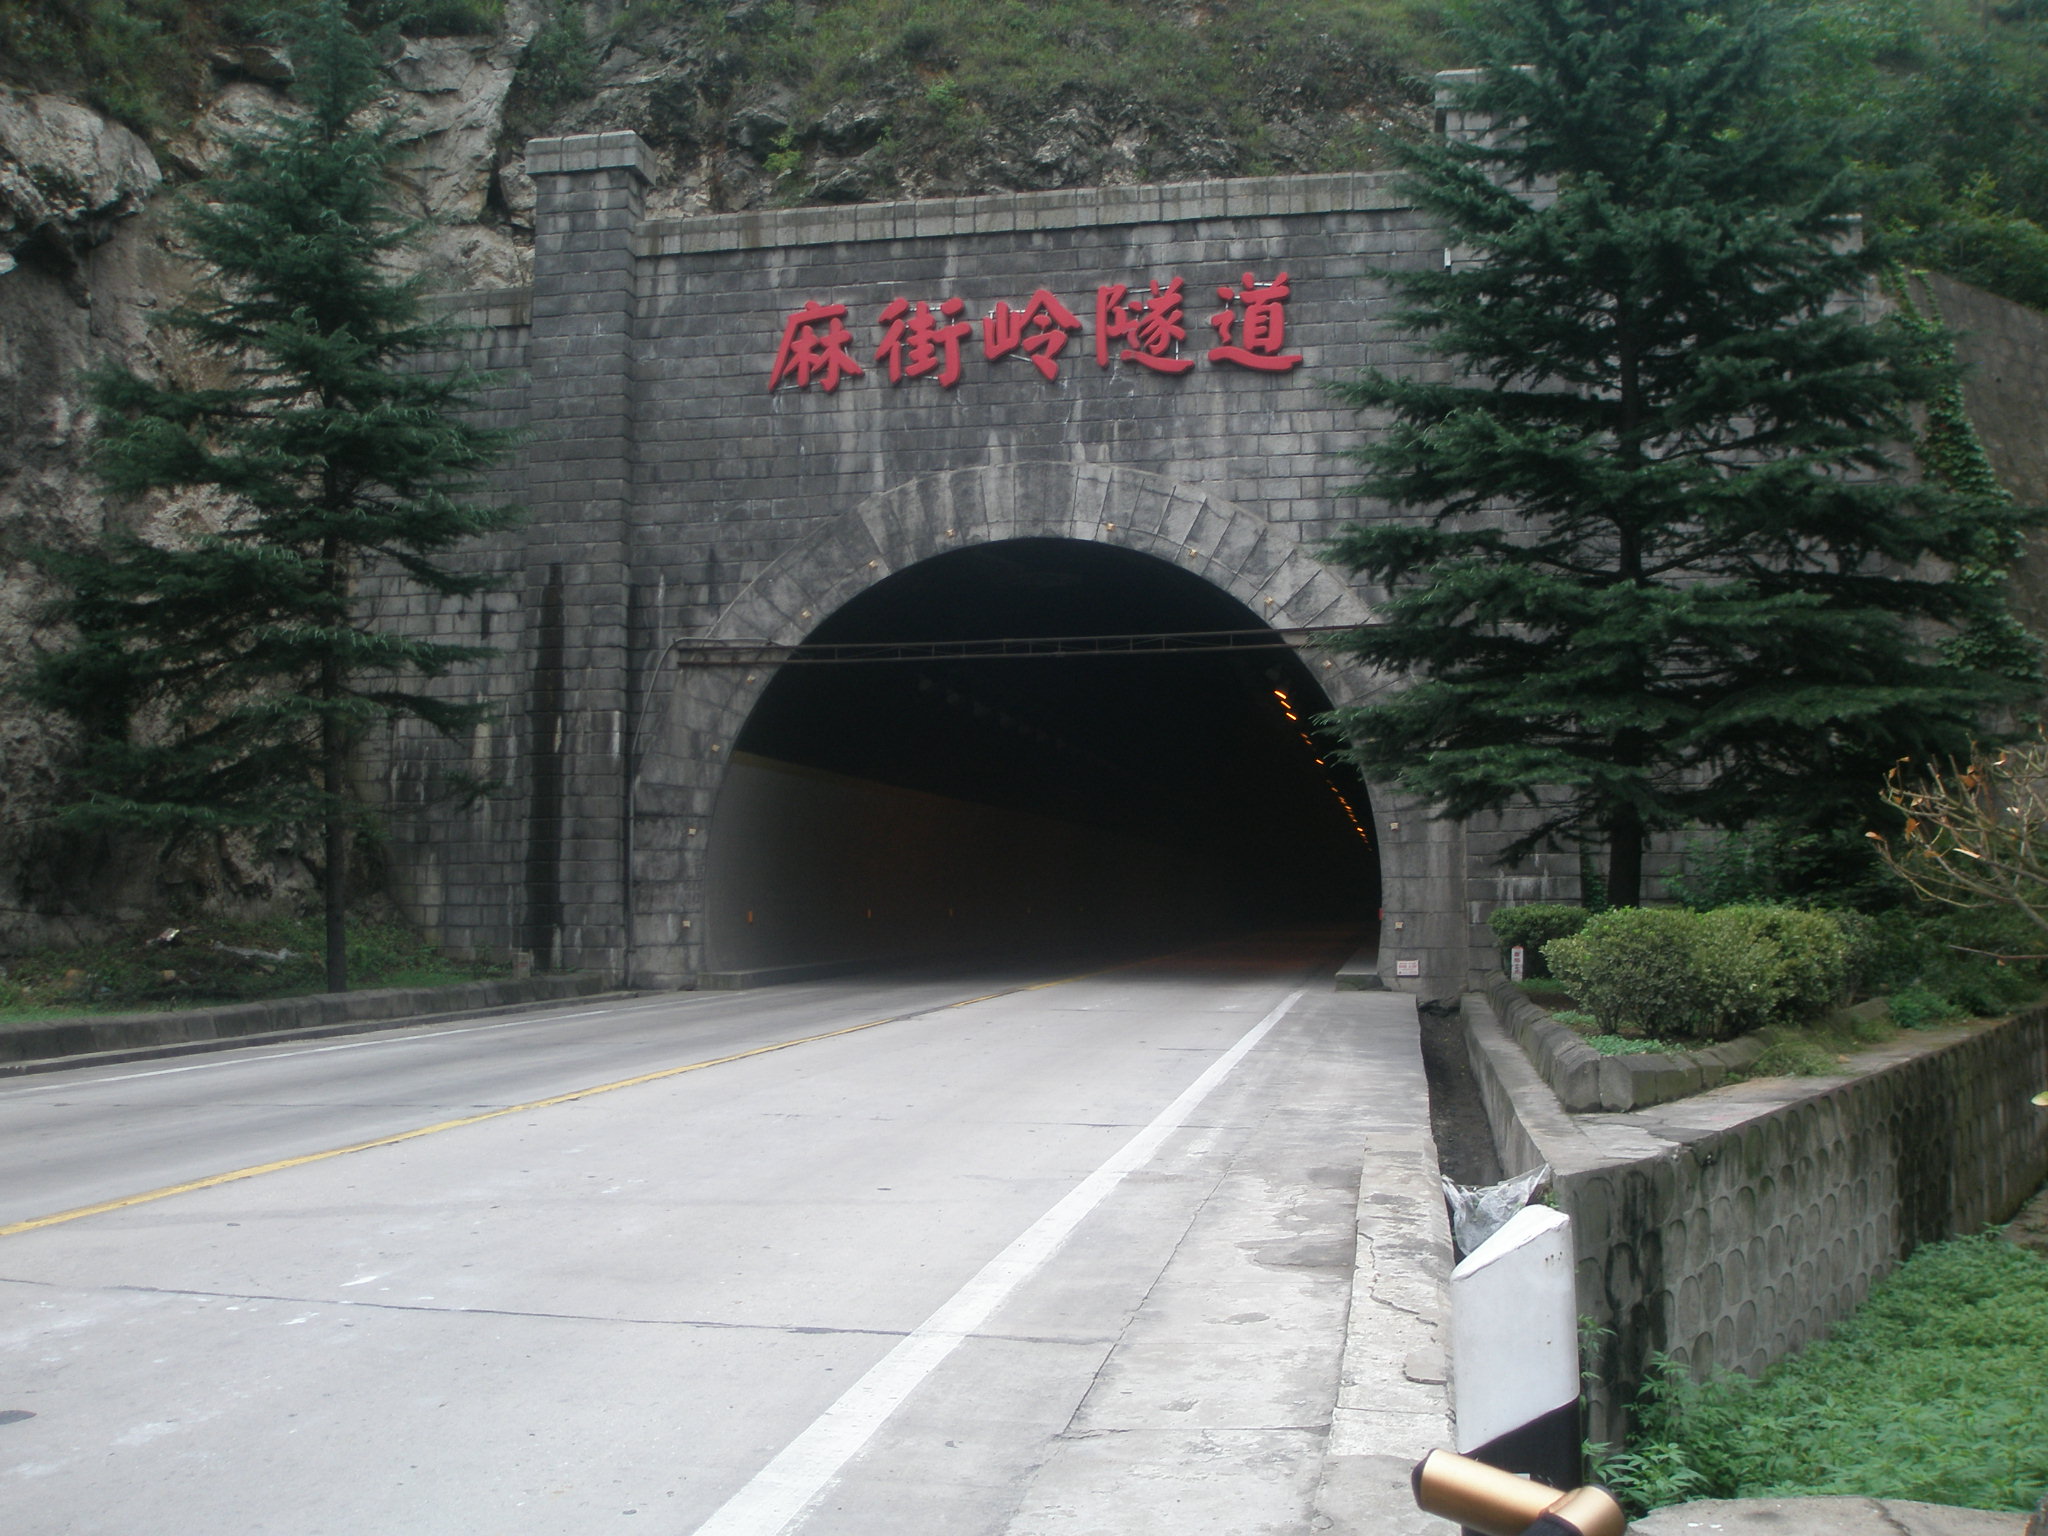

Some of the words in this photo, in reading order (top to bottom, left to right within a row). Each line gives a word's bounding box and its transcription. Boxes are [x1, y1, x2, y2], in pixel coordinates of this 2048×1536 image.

[768, 272, 1303, 392] 麻街岭隧道
